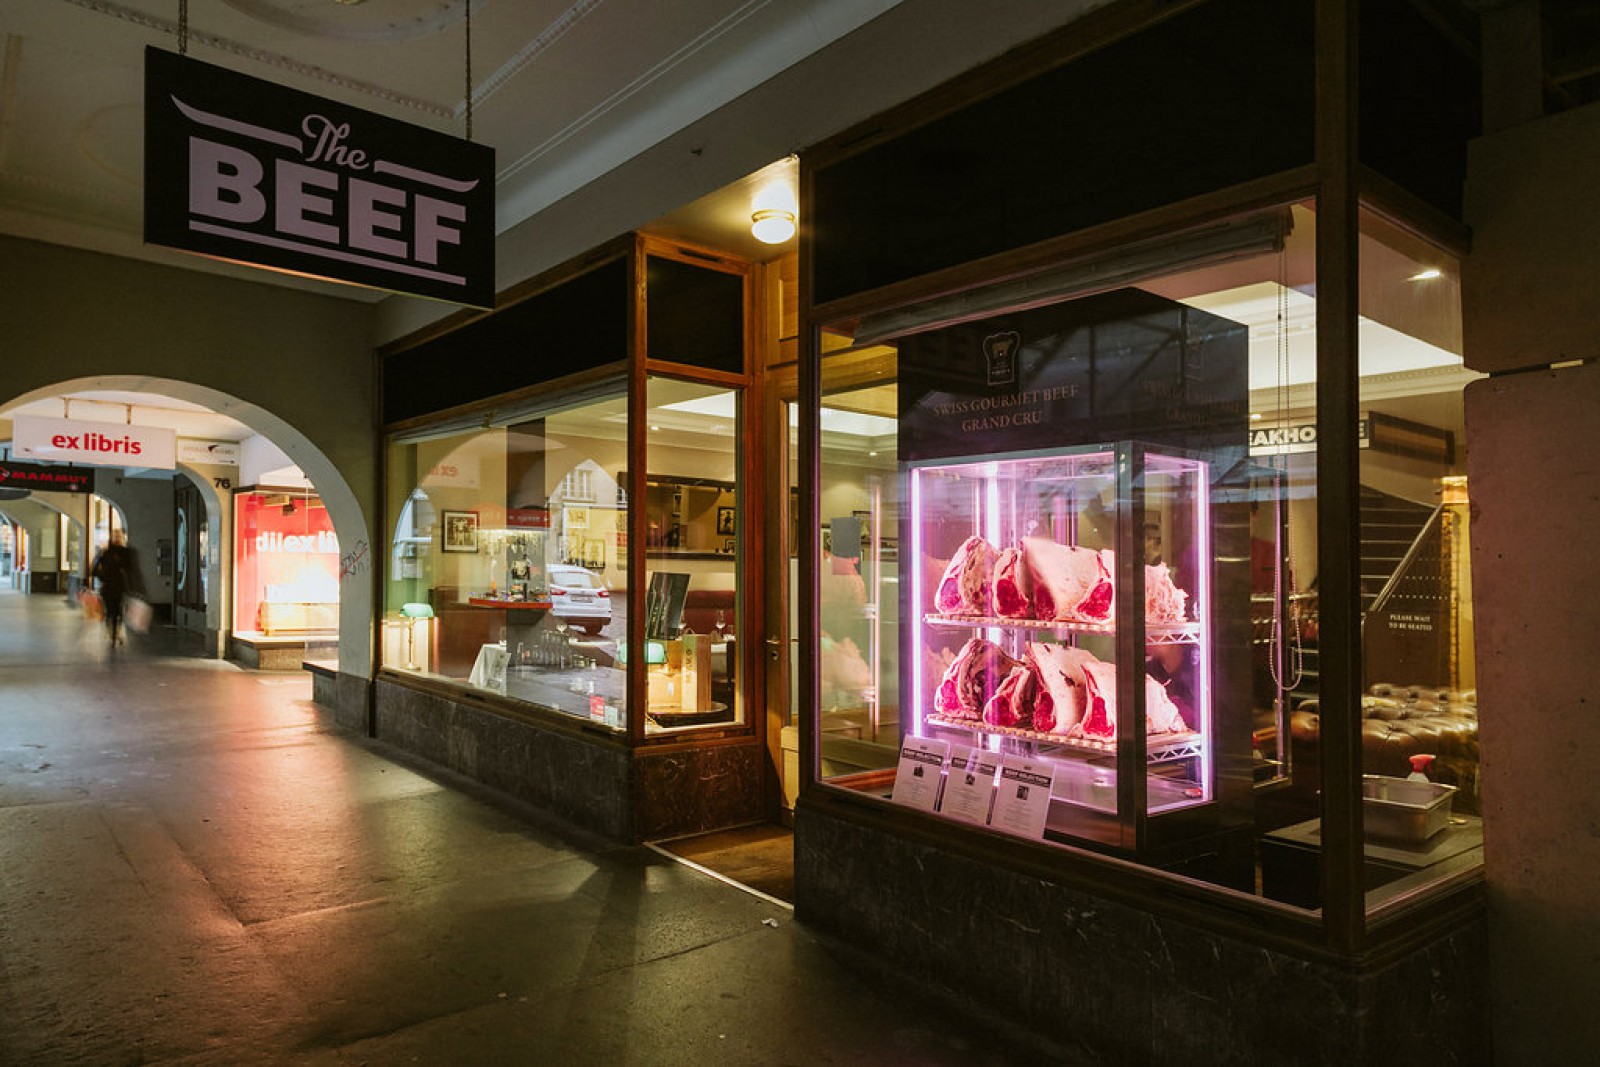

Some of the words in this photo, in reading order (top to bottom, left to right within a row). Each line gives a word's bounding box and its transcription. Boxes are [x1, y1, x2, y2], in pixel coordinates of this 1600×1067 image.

[302, 114, 369, 170] The
[189, 136, 466, 265] BEEF
[934, 400, 967, 416] SWISS
[971, 390, 1040, 412] GOURMET
[1043, 384, 1079, 401] BEEF
[962, 414, 1010, 432] GRAND
[1013, 411, 1042, 426] CRU
[52, 435, 80, 450] ex
[84, 433, 142, 455] libris
[11, 470, 87, 484] MAMMUT
[213, 477, 232, 490] 76
